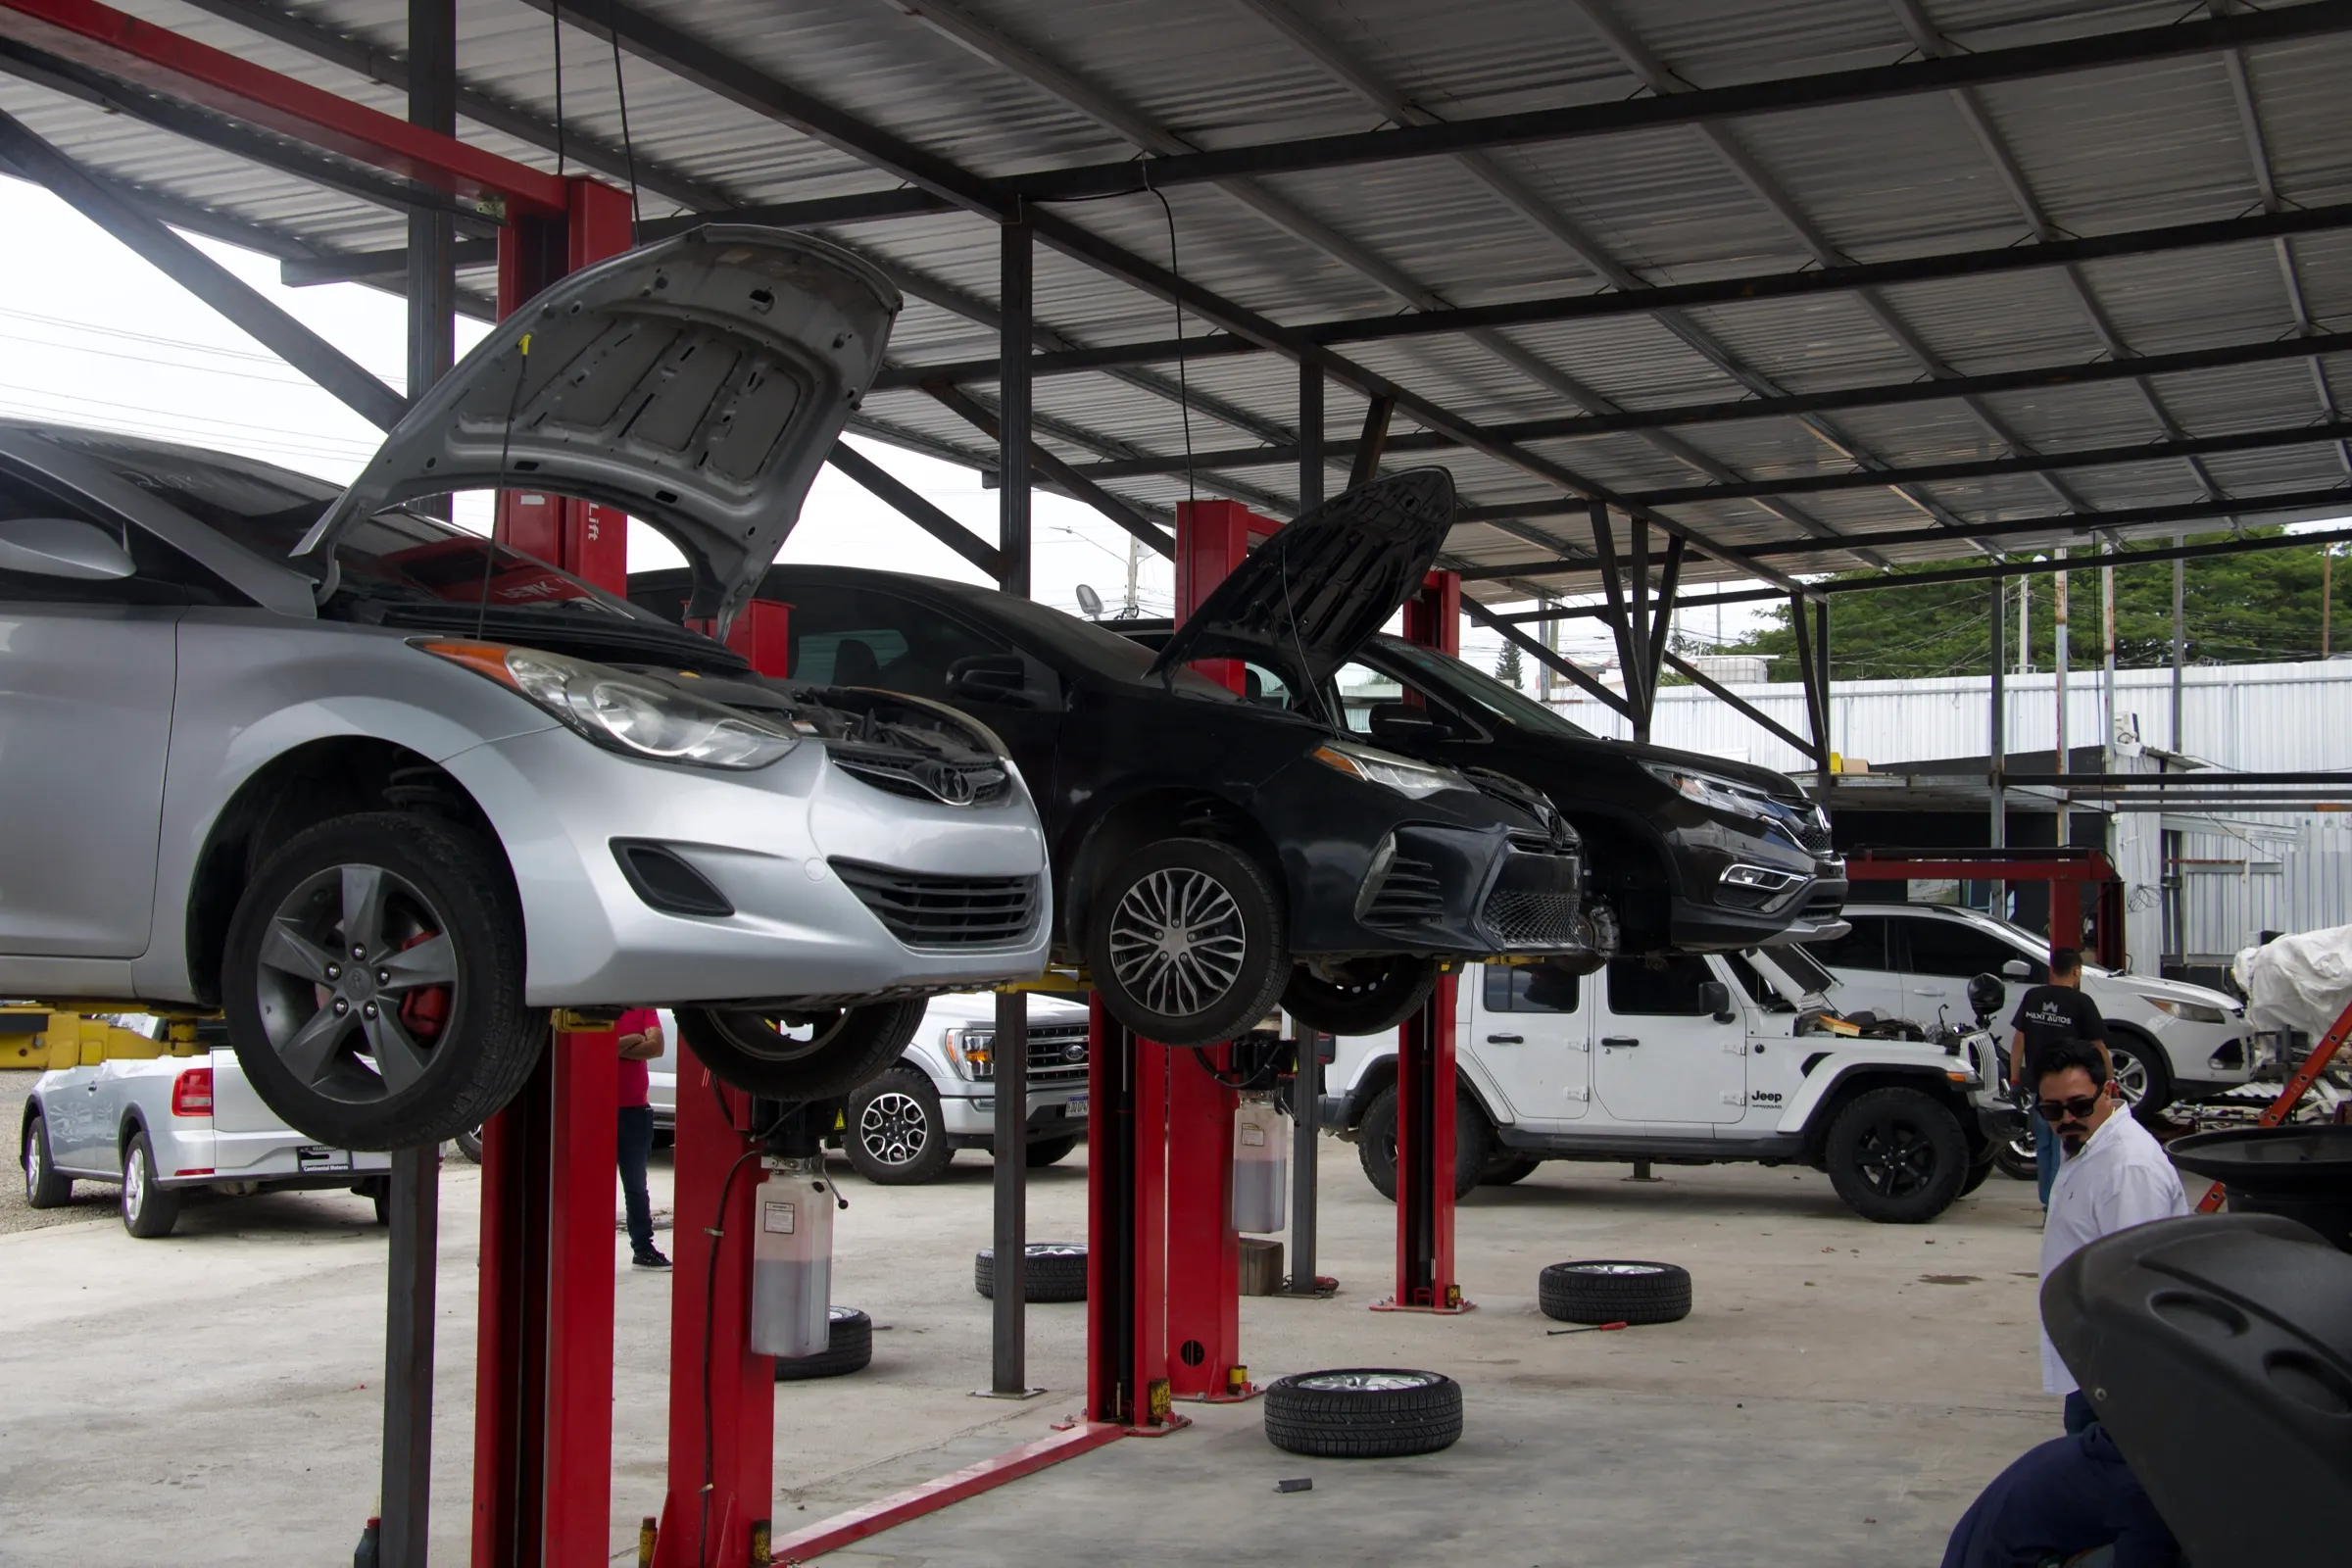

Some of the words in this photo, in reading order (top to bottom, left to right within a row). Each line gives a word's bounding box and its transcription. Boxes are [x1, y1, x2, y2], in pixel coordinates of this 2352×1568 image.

[588, 502, 600, 541] Lift
[2025, 1010, 2045, 1020] MAXI
[2046, 1014, 2072, 1025] AUTOS
[1751, 1090, 1783, 1102] Jeep
